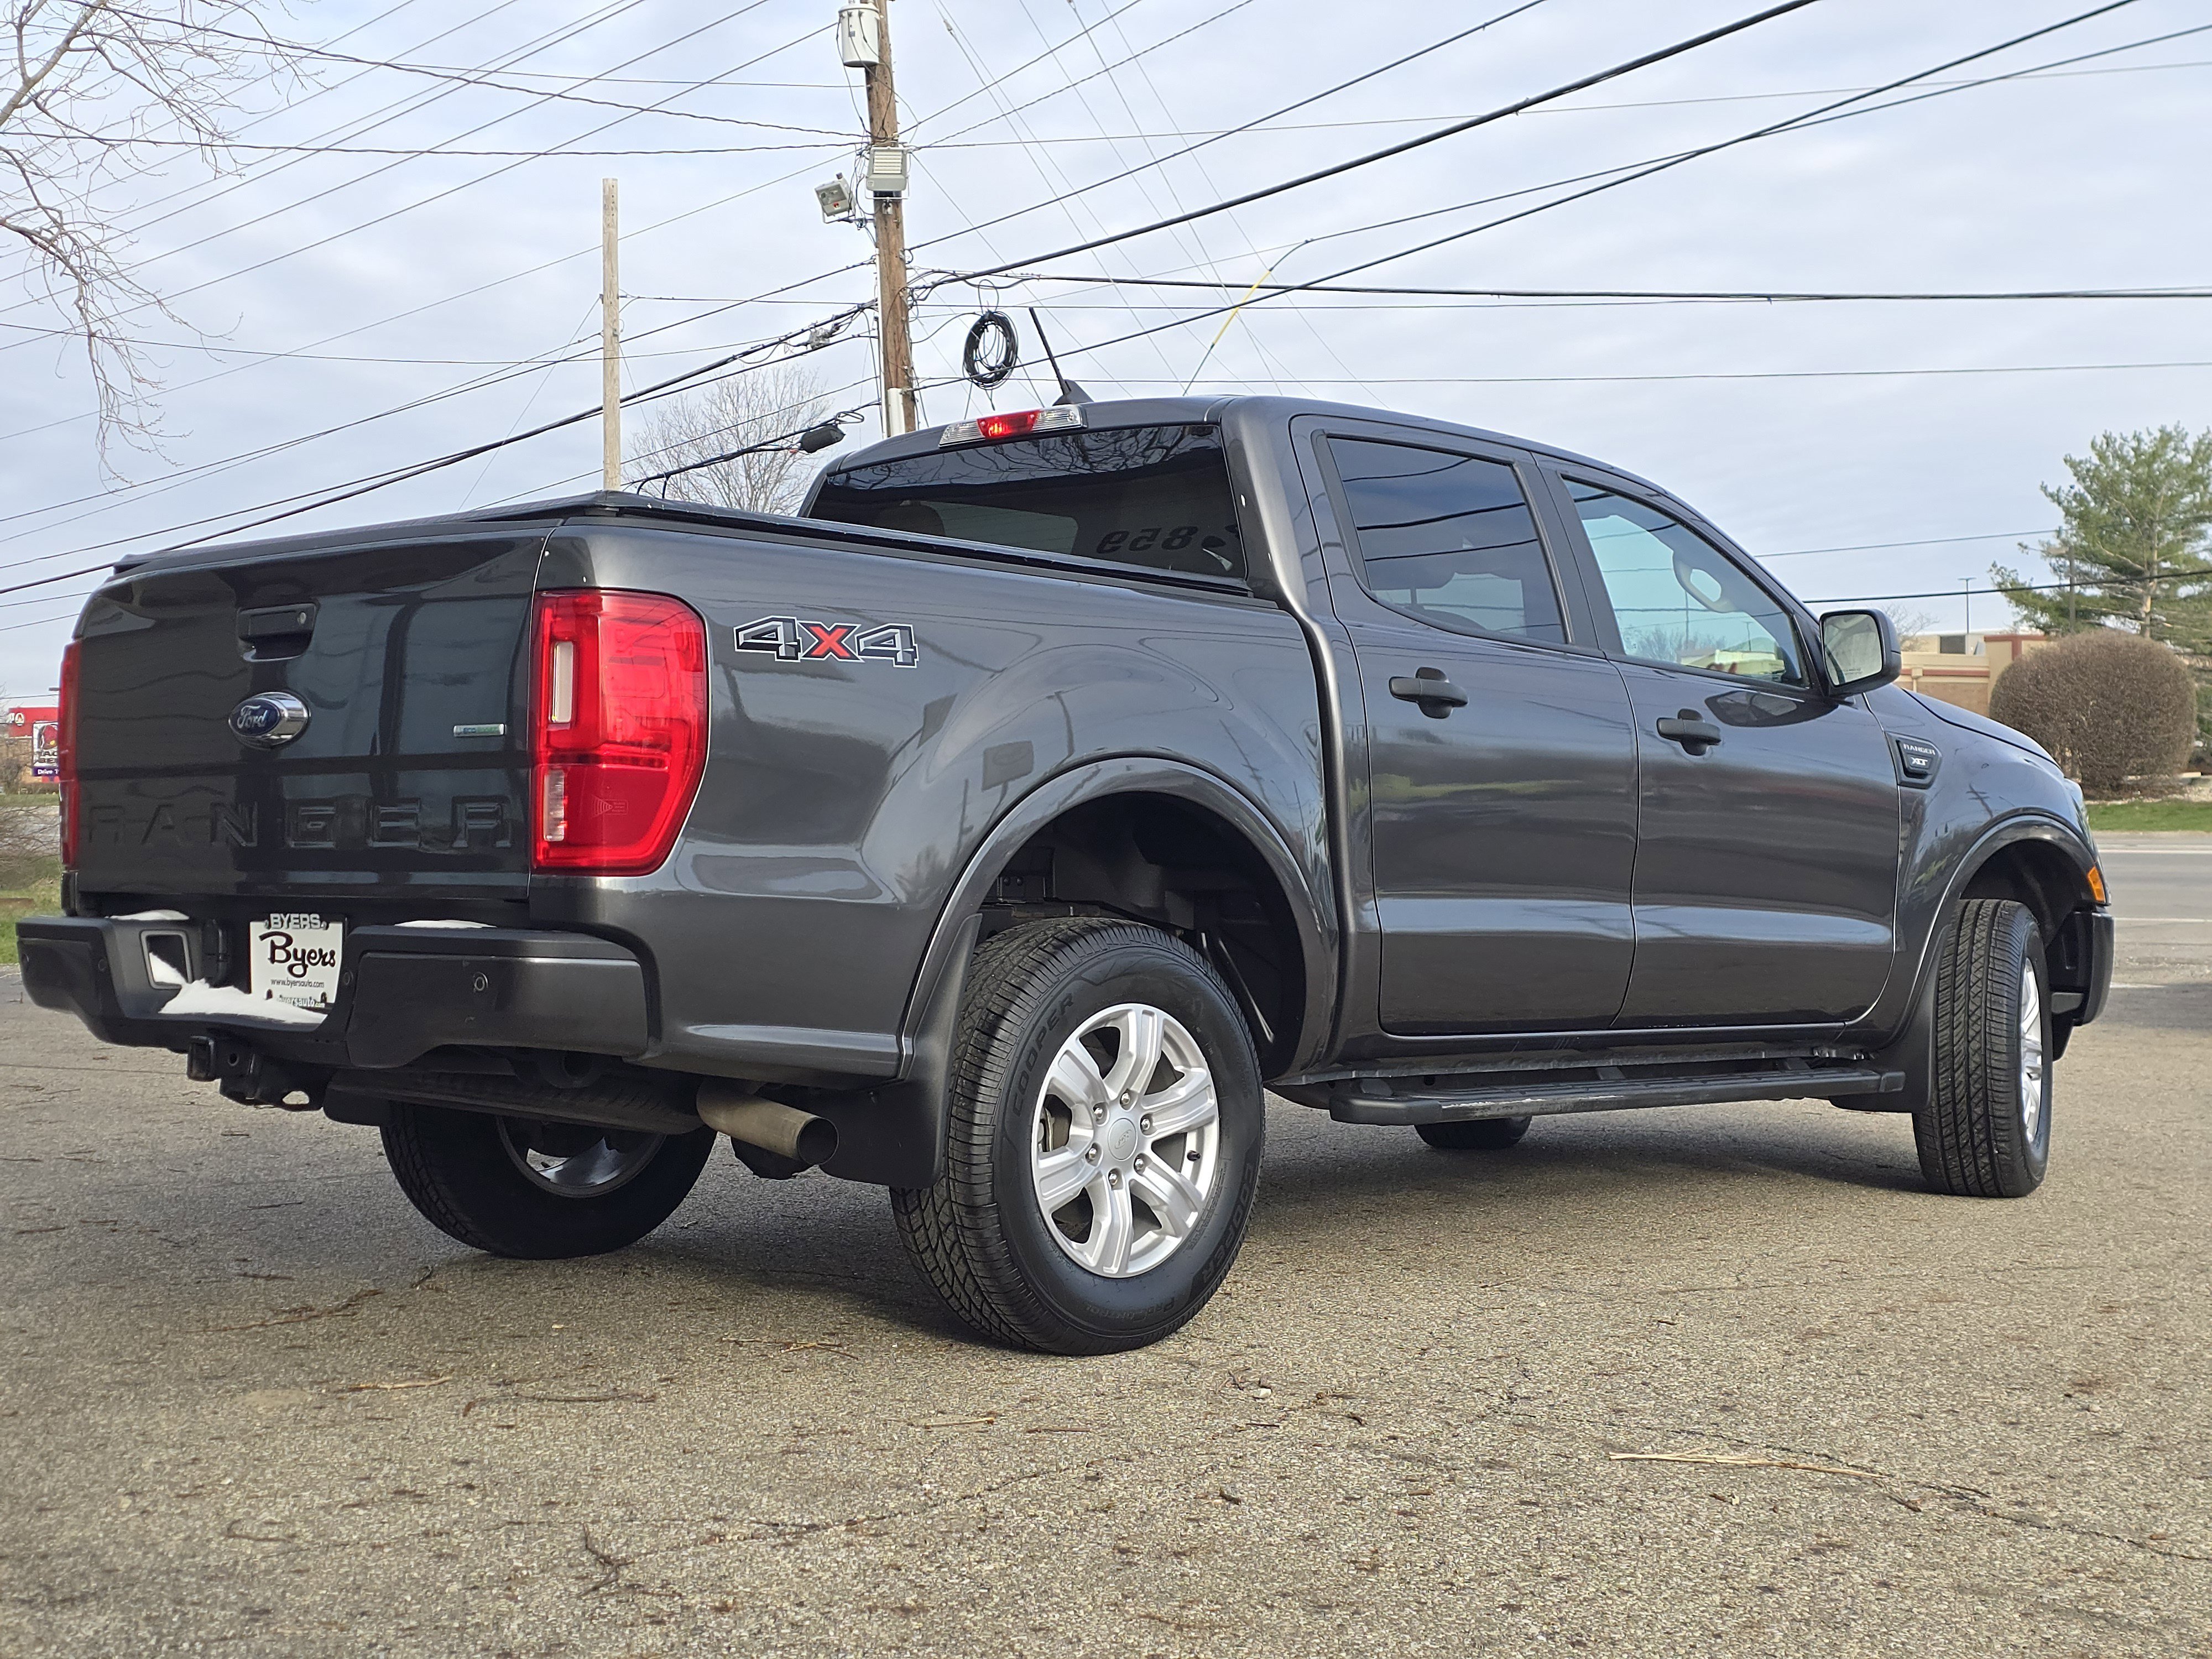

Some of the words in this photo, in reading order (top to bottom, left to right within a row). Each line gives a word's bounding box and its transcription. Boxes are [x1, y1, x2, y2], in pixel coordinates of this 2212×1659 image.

[237, 705, 268, 729] Ford
[1903, 743, 1936, 755] RANGER
[1910, 757, 1928, 766] XLT
[88, 796, 511, 848] RANGER
[269, 913, 321, 930] BYERS
[259, 931, 336, 978] Byers
[270, 977, 325, 988] www.byersauto.com
[1013, 993, 1074, 1117] COOPER
